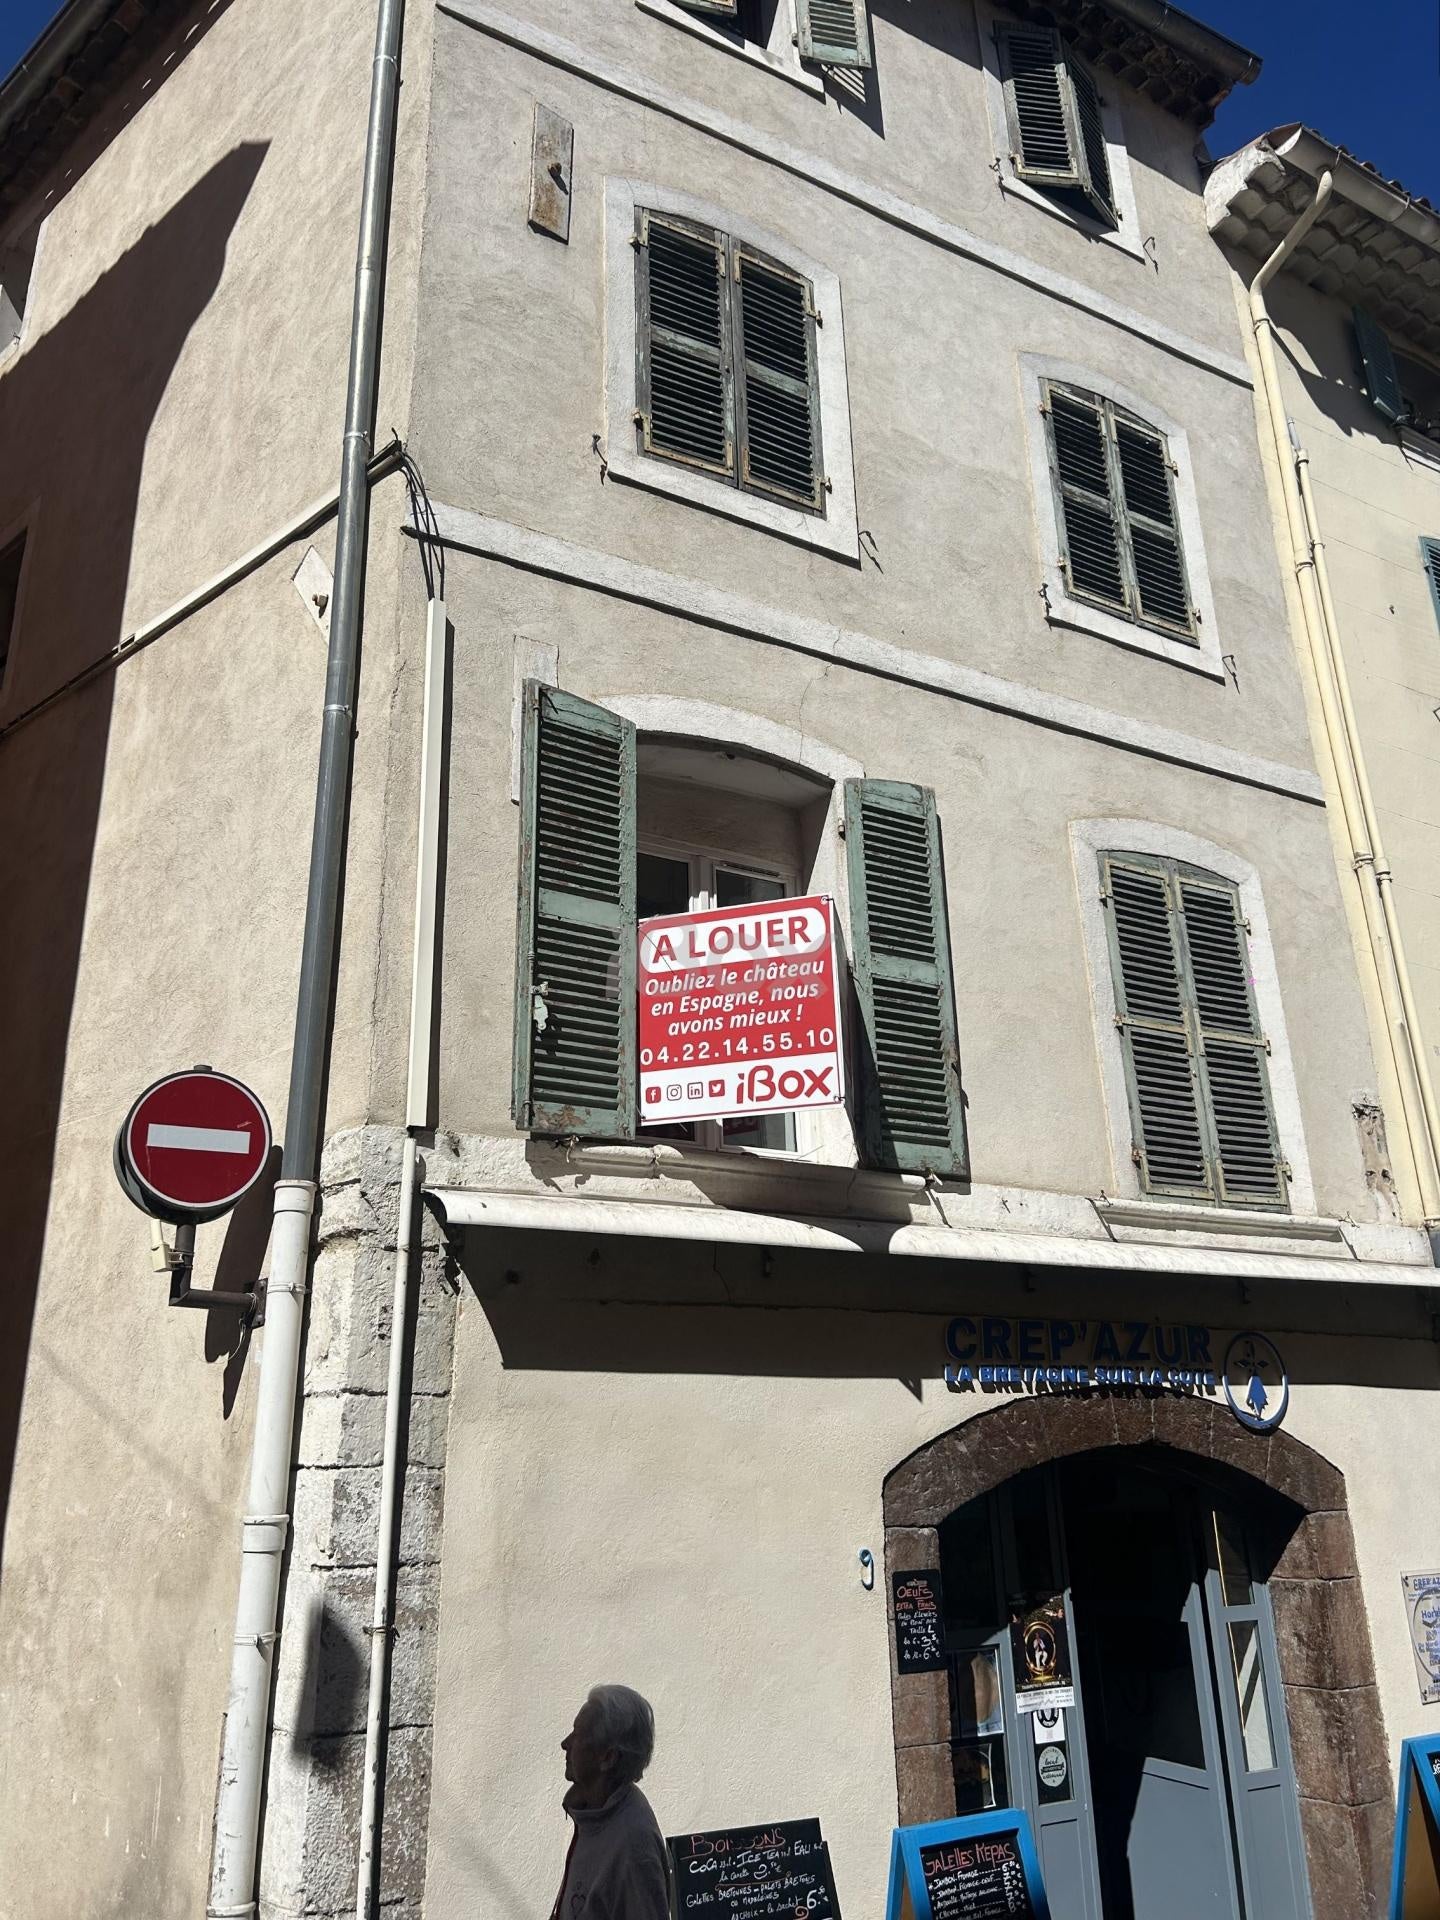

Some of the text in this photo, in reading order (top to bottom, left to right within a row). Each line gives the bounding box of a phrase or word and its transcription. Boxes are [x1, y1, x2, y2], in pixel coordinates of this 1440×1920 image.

[652, 915, 811, 964] A LOUER
[645, 960, 825, 996] Oubliez le château
[651, 983, 819, 1016] en Espagne, nous
[668, 1004, 804, 1036] avons mieux !
[640, 1028, 834, 1066] 04.22.14.55.10
[945, 1317, 1212, 1364] CREP'AZUR
[944, 1364, 974, 1382] LA
[978, 1364, 1090, 1384] BRETAGNE
[1094, 1368, 1134, 1385] SUR
[1140, 1368, 1163, 1386] LA
